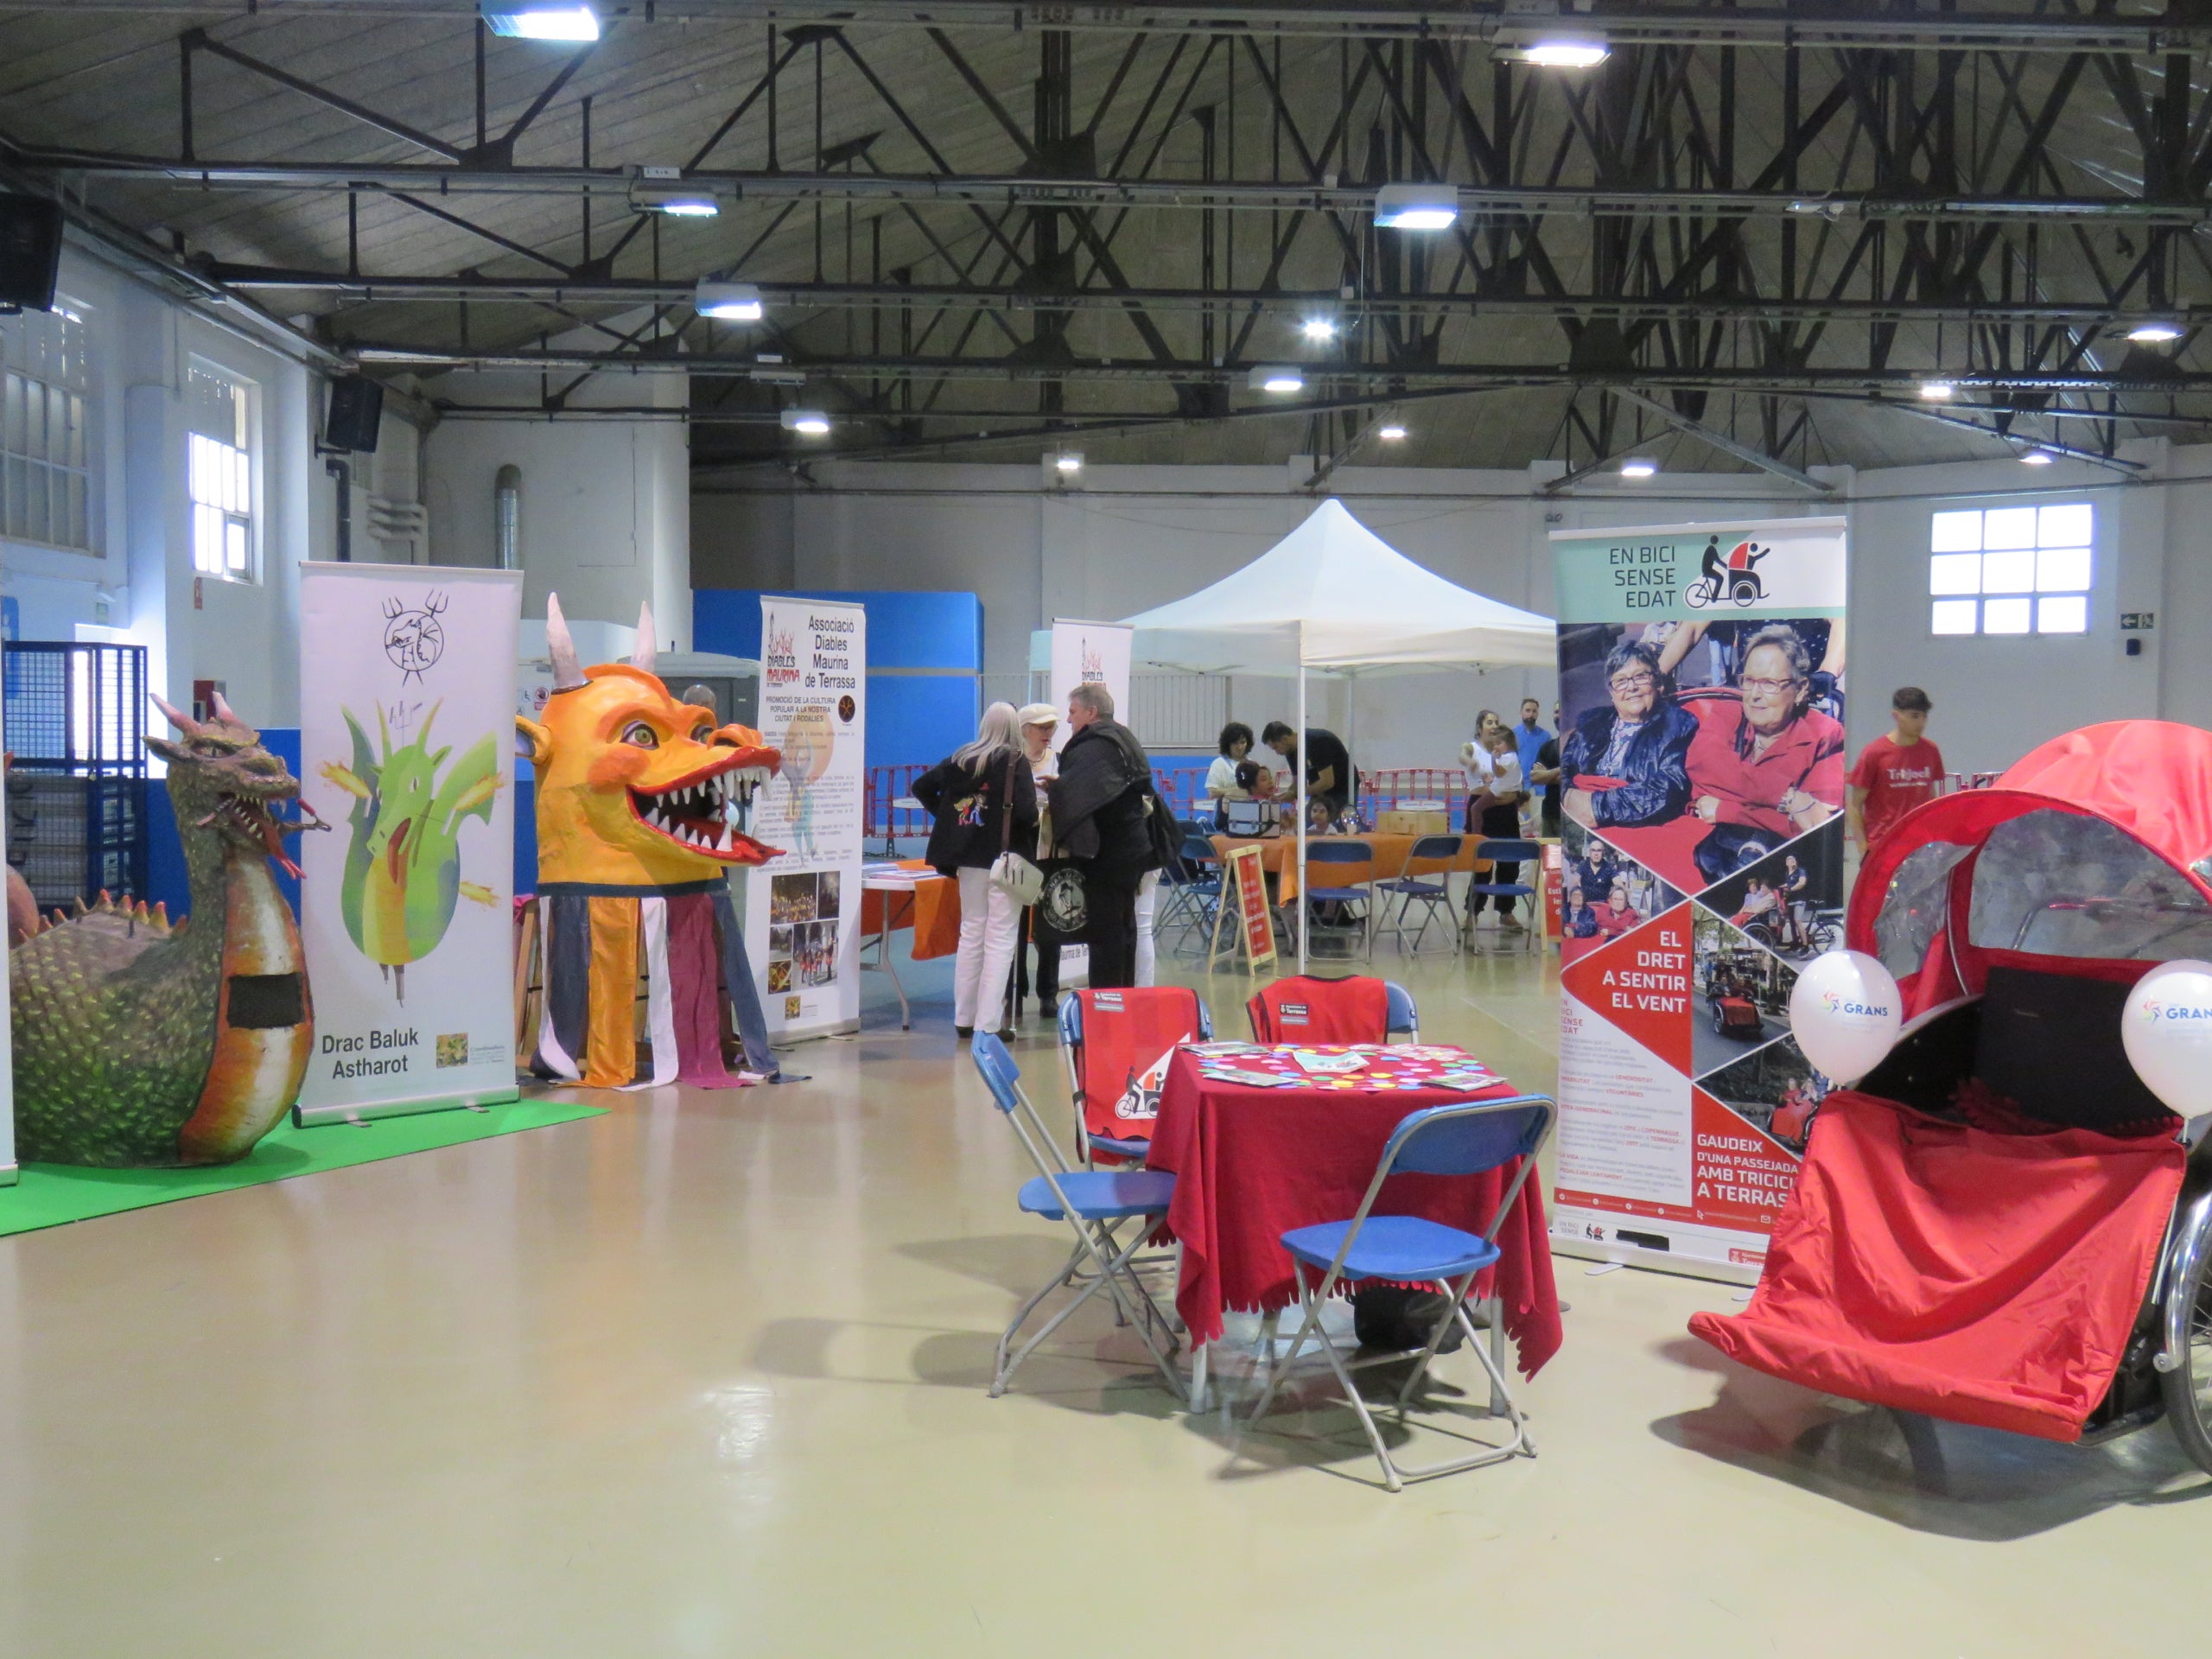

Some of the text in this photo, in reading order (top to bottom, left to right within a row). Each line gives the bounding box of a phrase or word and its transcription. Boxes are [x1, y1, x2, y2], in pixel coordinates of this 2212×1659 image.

[1610, 546, 1675, 564] EN BICI
[1614, 569, 1676, 587] SENSE
[1626, 590, 1676, 608] EDAT
[809, 614, 855, 633] Associació
[815, 634, 848, 652] Diables
[767, 655, 796, 668] DIABLES
[812, 654, 849, 671] Maurina
[804, 672, 856, 690] de Terrassa
[1660, 931, 1682, 948] EL
[1637, 950, 1687, 969] DRET
[1602, 969, 1686, 992] A SENTIR
[1611, 992, 1687, 1014] EL VENT
[1843, 1002, 1888, 1017] GRANS
[321, 1027, 419, 1054] Drac Baluk
[333, 1055, 409, 1079] Astharot
[1697, 1134, 1764, 1153] GAUDEIX
[1696, 1152, 1799, 1174] D'UNA PASSEJADA
[1696, 1165, 1733, 1182] AMB
[1696, 1182, 1711, 1198] A
